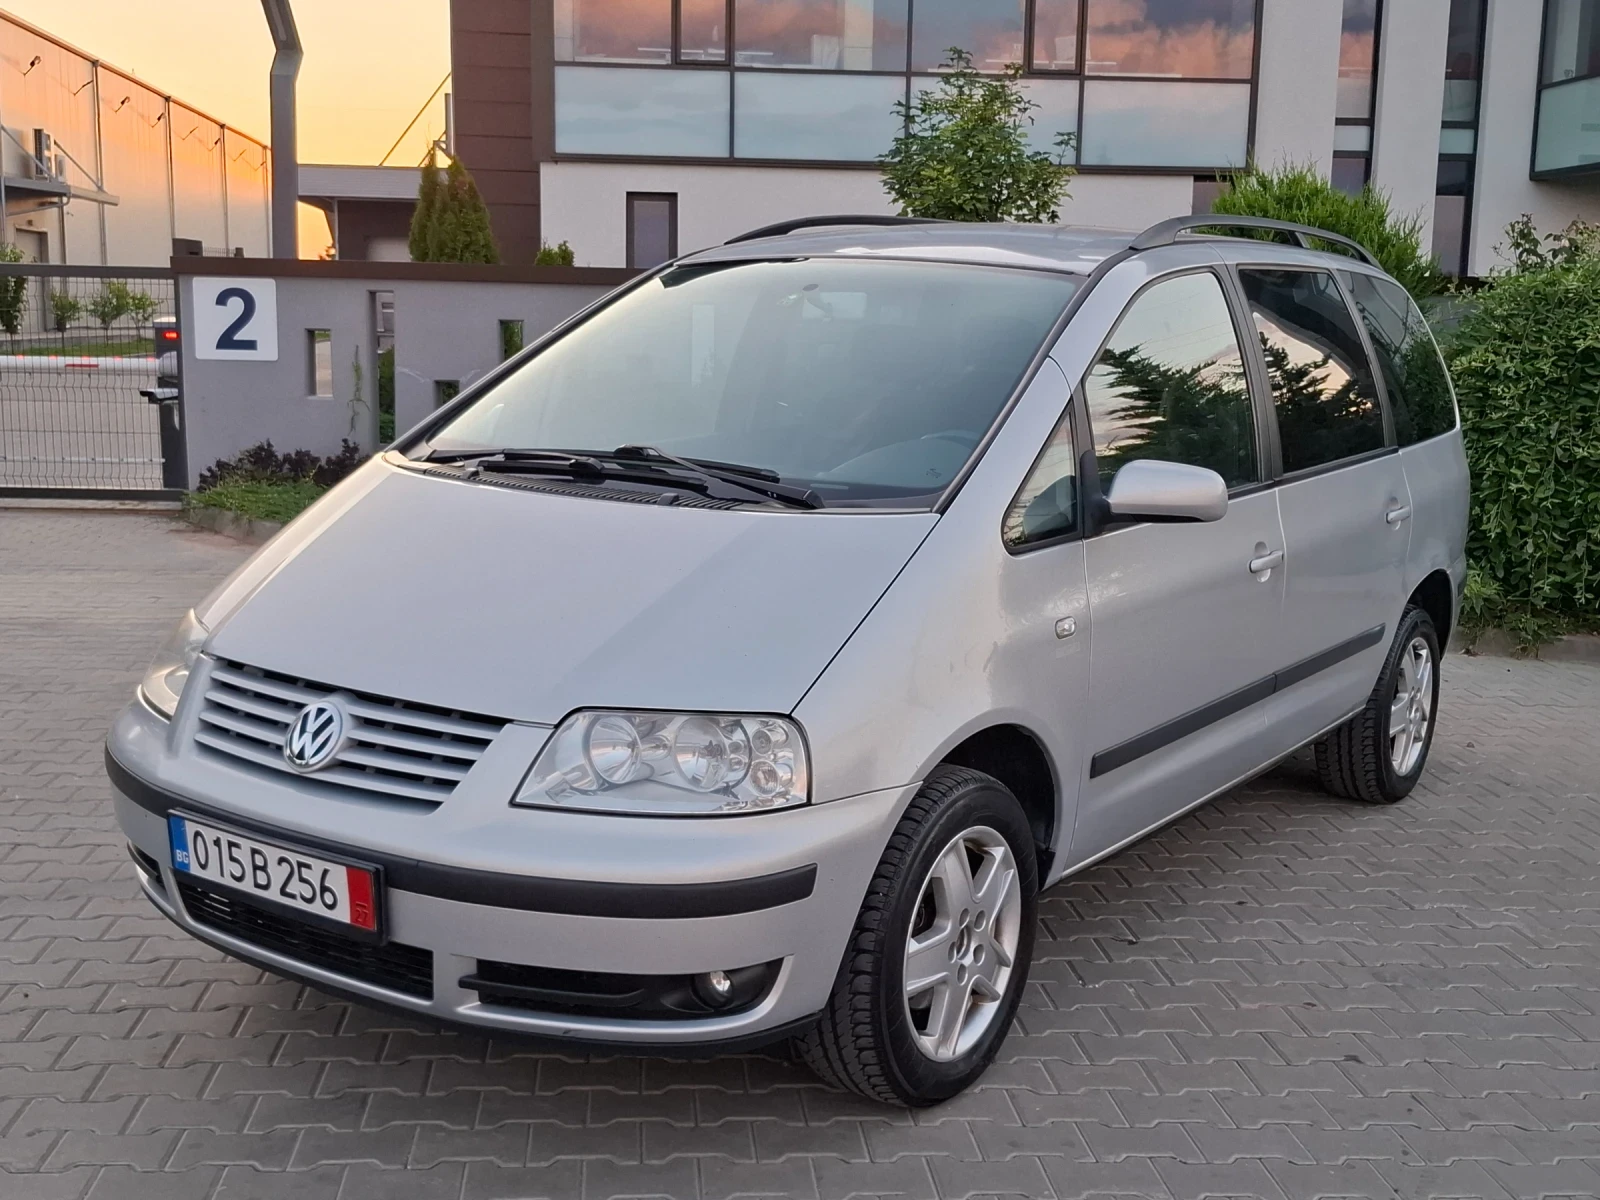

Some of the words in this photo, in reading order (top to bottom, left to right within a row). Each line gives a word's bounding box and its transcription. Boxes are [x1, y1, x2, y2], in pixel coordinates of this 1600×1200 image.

[215, 287, 258, 350] 2
[289, 703, 339, 765] VW
[176, 849, 189, 864] BG
